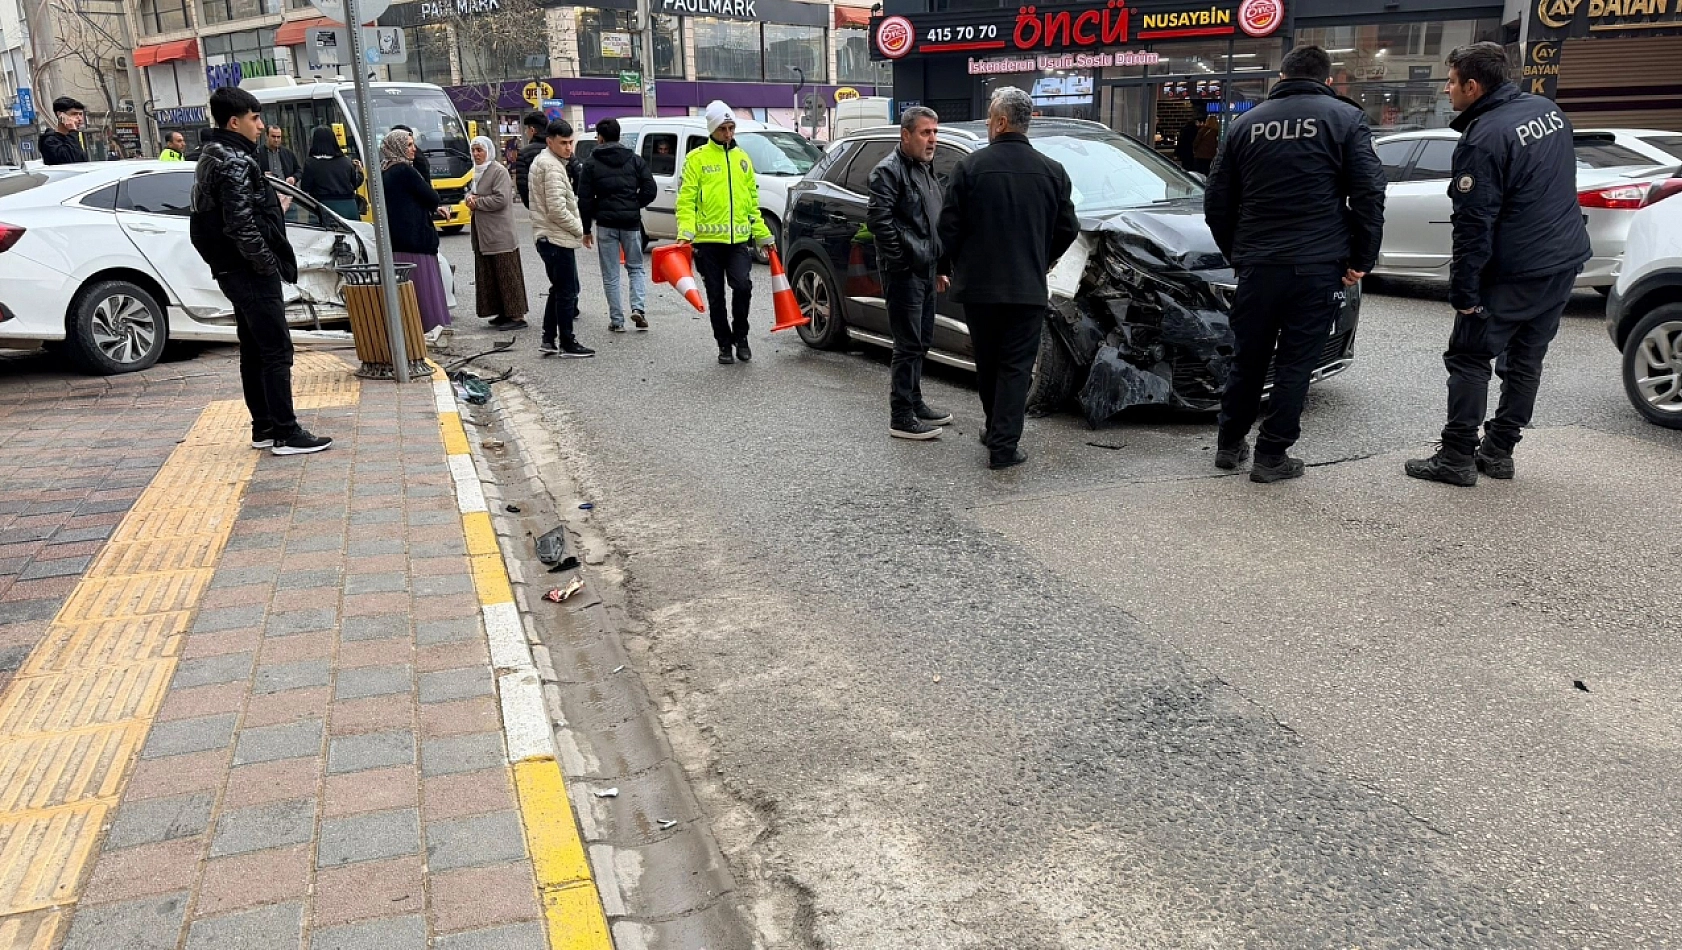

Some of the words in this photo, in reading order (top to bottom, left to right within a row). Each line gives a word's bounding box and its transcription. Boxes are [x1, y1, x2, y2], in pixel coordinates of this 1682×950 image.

[1587, 0, 1668, 17] BAYAN
[1143, 6, 1231, 29] NUSAYBİN
[927, 28, 951, 41] 415
[956, 26, 974, 39] 70
[979, 24, 997, 38] 70
[967, 56, 1036, 75] İskenderun
[1037, 53, 1075, 71] Usulü
[1075, 52, 1113, 68] Soslu
[1114, 49, 1160, 66] Dürüm
[1523, 64, 1559, 76] BAYAN
[1531, 78, 1546, 94] K
[1250, 118, 1318, 144] POLİS
